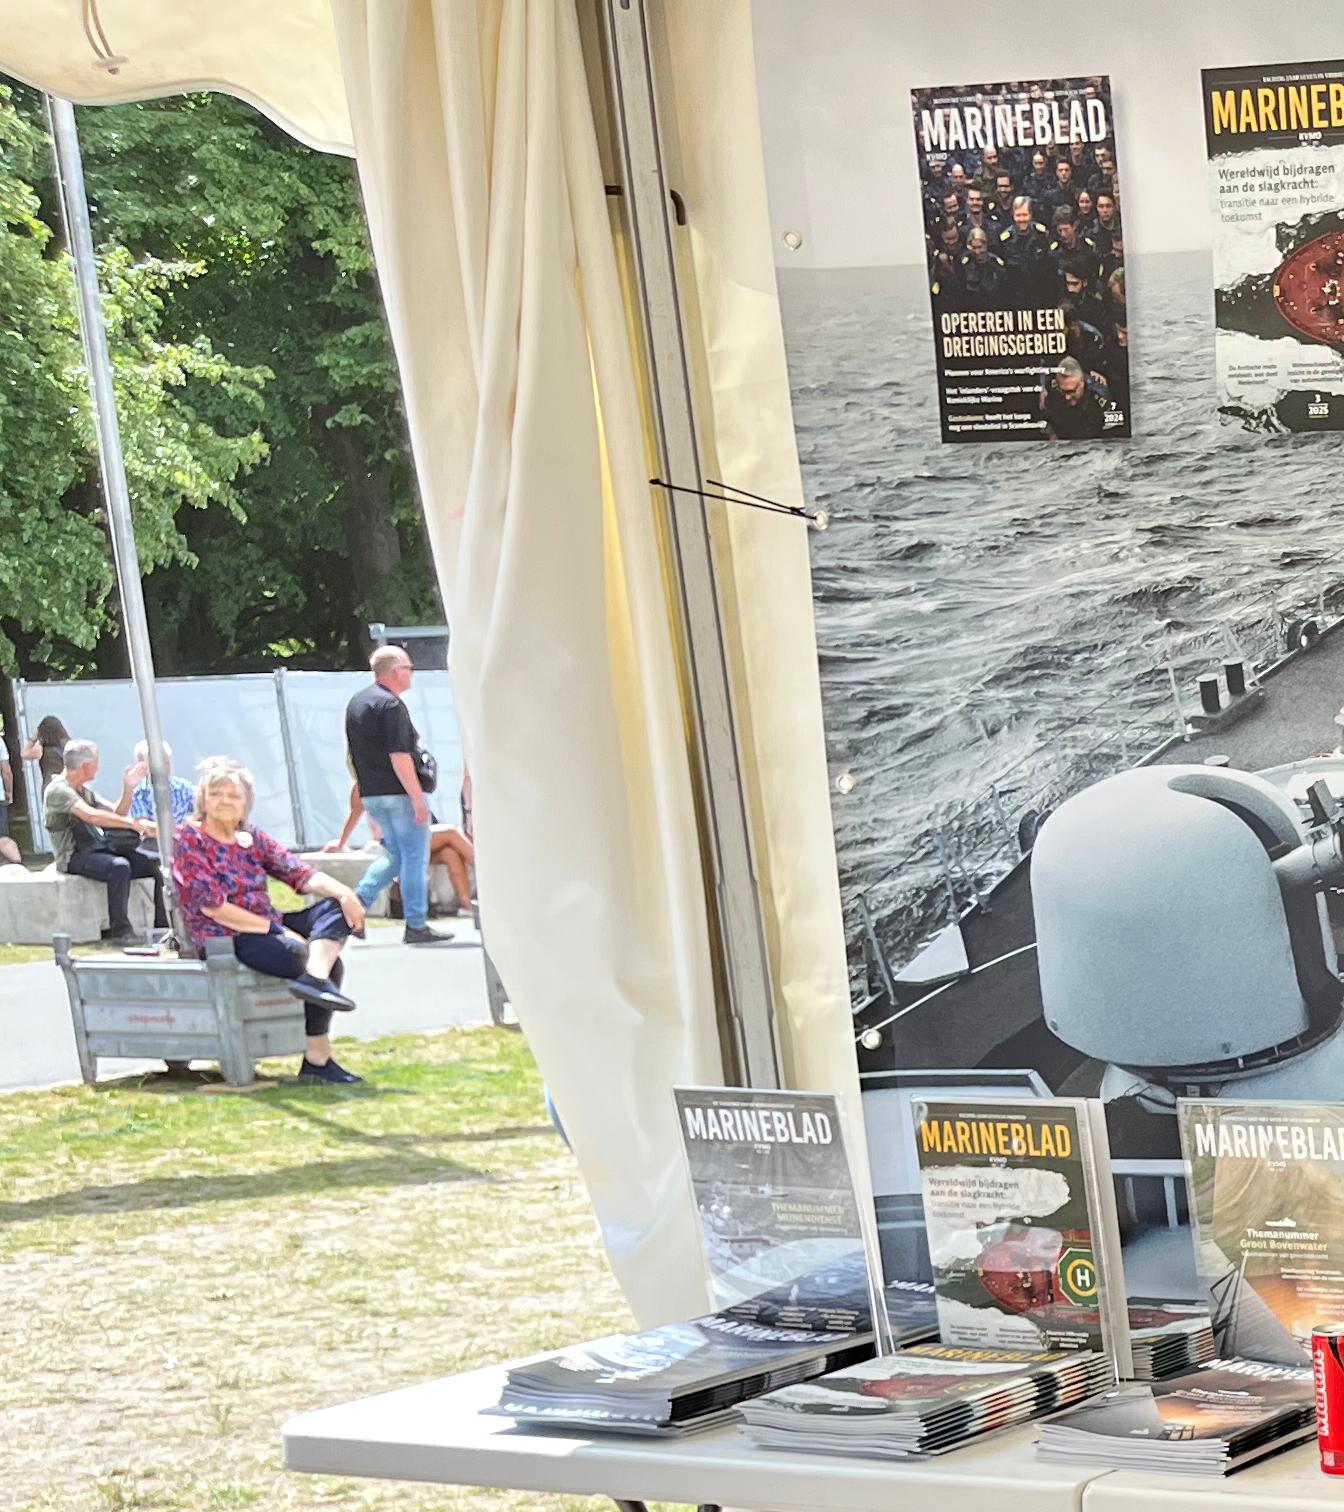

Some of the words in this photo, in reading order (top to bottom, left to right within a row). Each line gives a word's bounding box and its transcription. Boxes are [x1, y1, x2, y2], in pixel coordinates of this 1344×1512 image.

[922, 99, 1106, 152] MARINEBLAD
[1298, 131, 1322, 140] KVMO
[1218, 165, 1279, 179] Wereldwijd
[1283, 163, 1335, 176] bijdragen
[1219, 184, 1238, 193] aan
[1242, 182, 1255, 192] de
[1258, 179, 1318, 195] slagkracht:
[1220, 199, 1256, 208] transitie
[1300, 194, 1334, 206] hybride
[1221, 212, 1262, 222] toekomst
[941, 311, 1013, 334] OPEREREN
[1018, 311, 1033, 331] IN
[1037, 309, 1065, 330] EEN
[943, 333, 1066, 358] DREIGINGSGEBIED
[684, 1108, 832, 1145] MARINEBLAD
[921, 1120, 1071, 1157] MARINEBLAD
[979, 1179, 1019, 1189] bijdragen
[1246, 1228, 1319, 1240] Themanummer
[1240, 1239, 1267, 1248] Groot
[1270, 1240, 1327, 1251] Bovenwater
[1077, 1269, 1090, 1287] H
